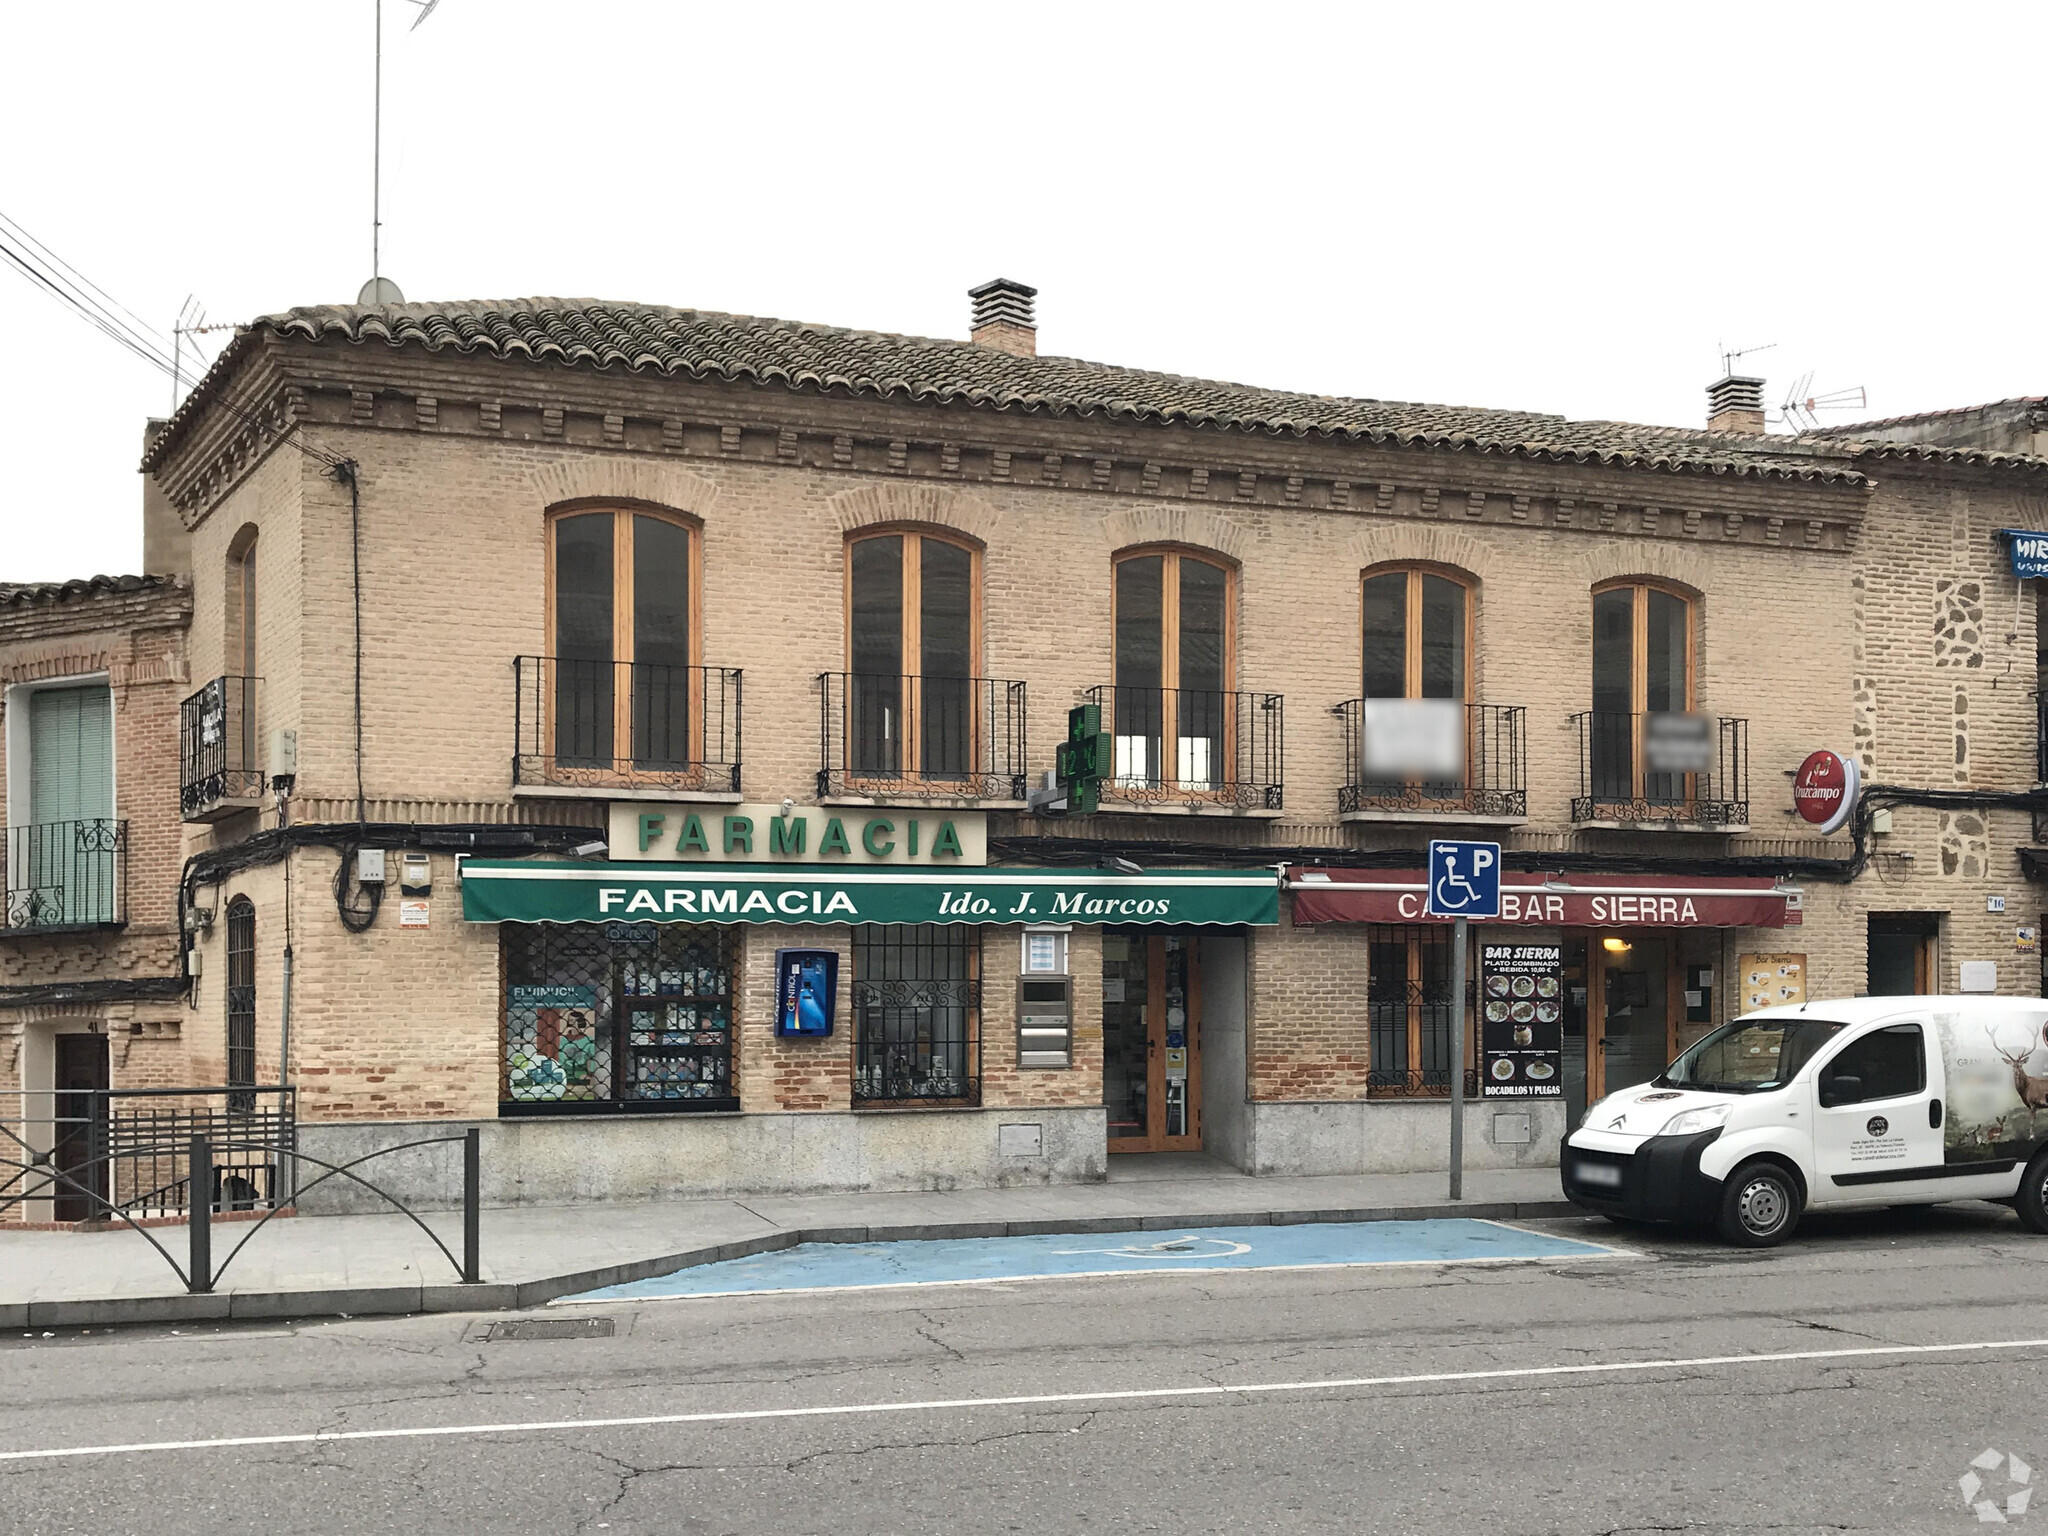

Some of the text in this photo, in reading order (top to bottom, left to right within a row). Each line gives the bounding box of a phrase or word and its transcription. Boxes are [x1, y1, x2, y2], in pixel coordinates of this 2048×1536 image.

[1795, 785, 1840, 801] Cruzcampo
[638, 813, 964, 858] FARMACIA
[1473, 849, 1494, 877] P
[599, 889, 859, 915] FARMACIA
[1009, 892, 1037, 915] J.
[1048, 892, 1170, 915] Marcos
[1502, 895, 1565, 921] BAR
[1591, 896, 1699, 922] SIERRA
[1993, 899, 2004, 909] 16
[1485, 947, 1560, 960] BAR SIERRA
[1755, 954, 1769, 964] Bar
[1485, 1085, 1561, 1095] BOCADILLOS Y PULGAS
